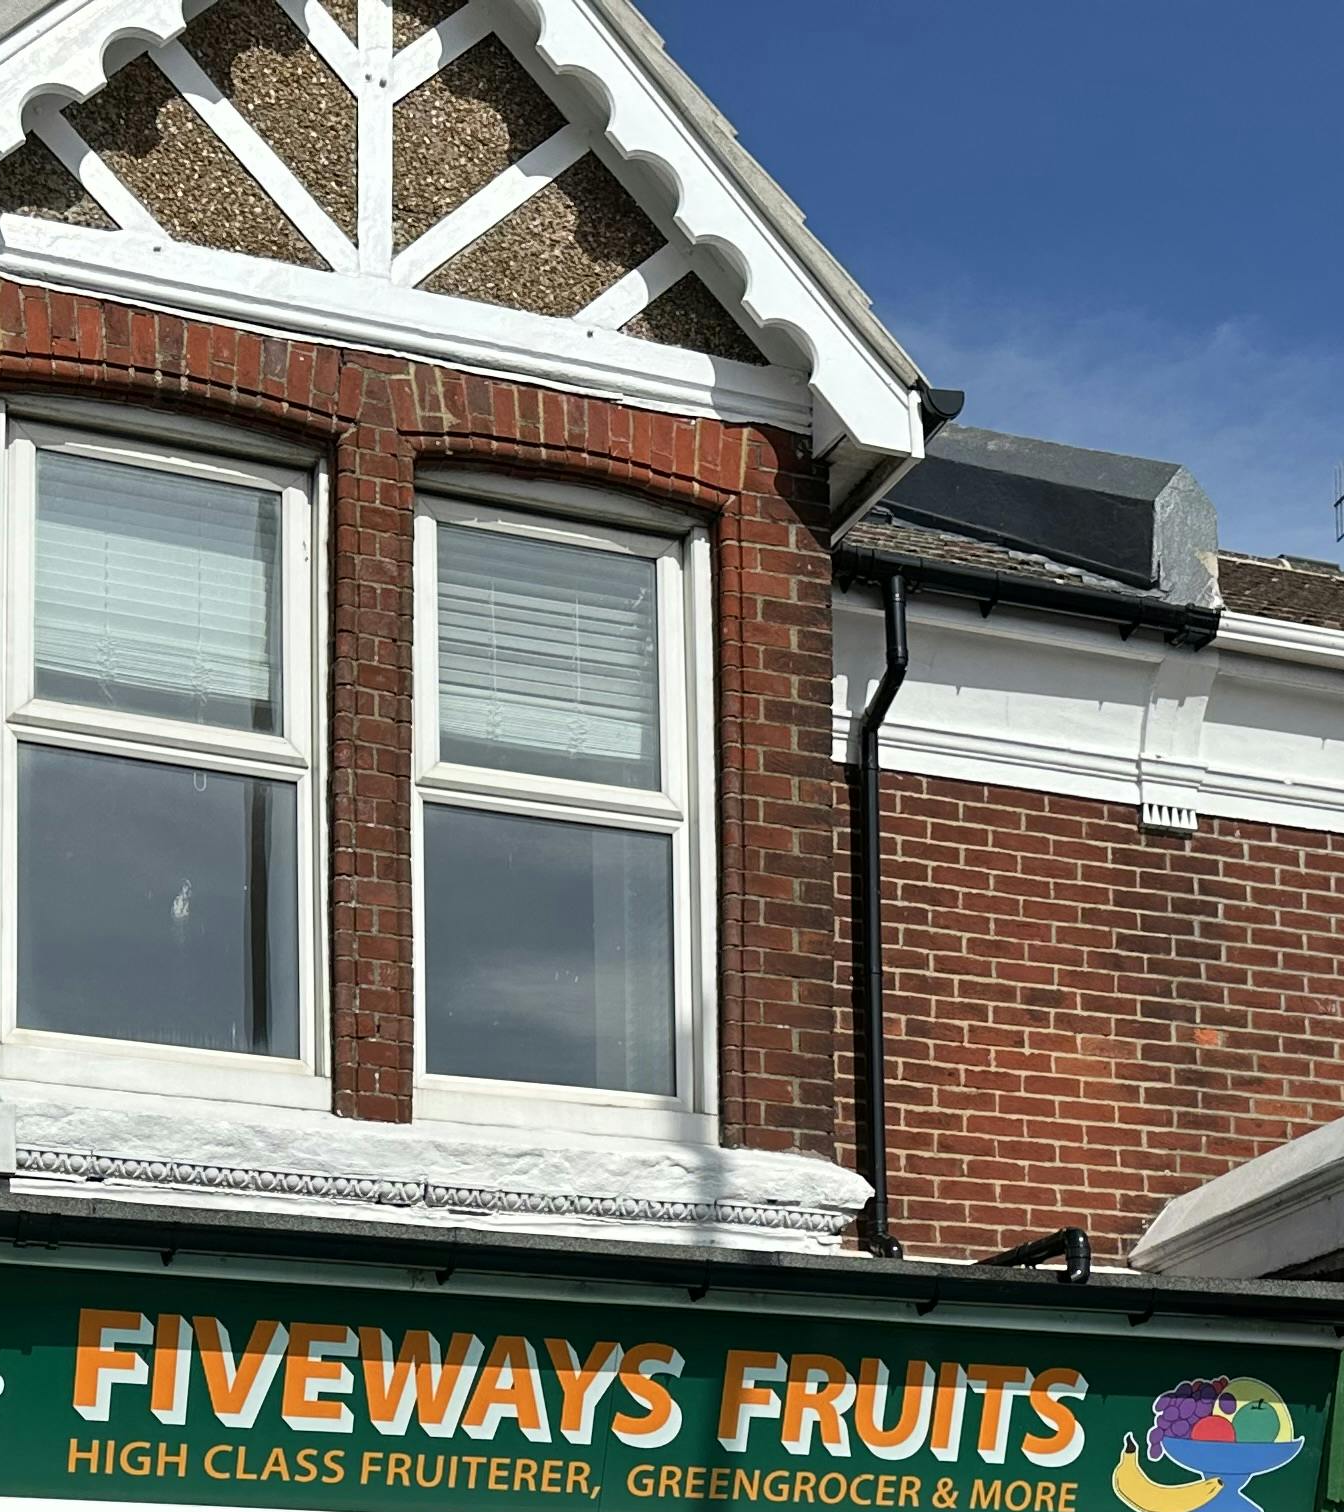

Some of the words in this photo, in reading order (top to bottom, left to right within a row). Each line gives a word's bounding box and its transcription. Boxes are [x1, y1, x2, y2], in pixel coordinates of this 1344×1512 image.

[73, 1307, 685, 1449] FIVEWAYS
[717, 1349, 1089, 1466] FRUITS
[67, 1438, 187, 1477] HIGH
[203, 1444, 345, 1484] CLASS
[360, 1450, 601, 1500] FRUITERER,
[626, 1463, 920, 1509] GREENGROCER
[931, 1478, 958, 1509] &
